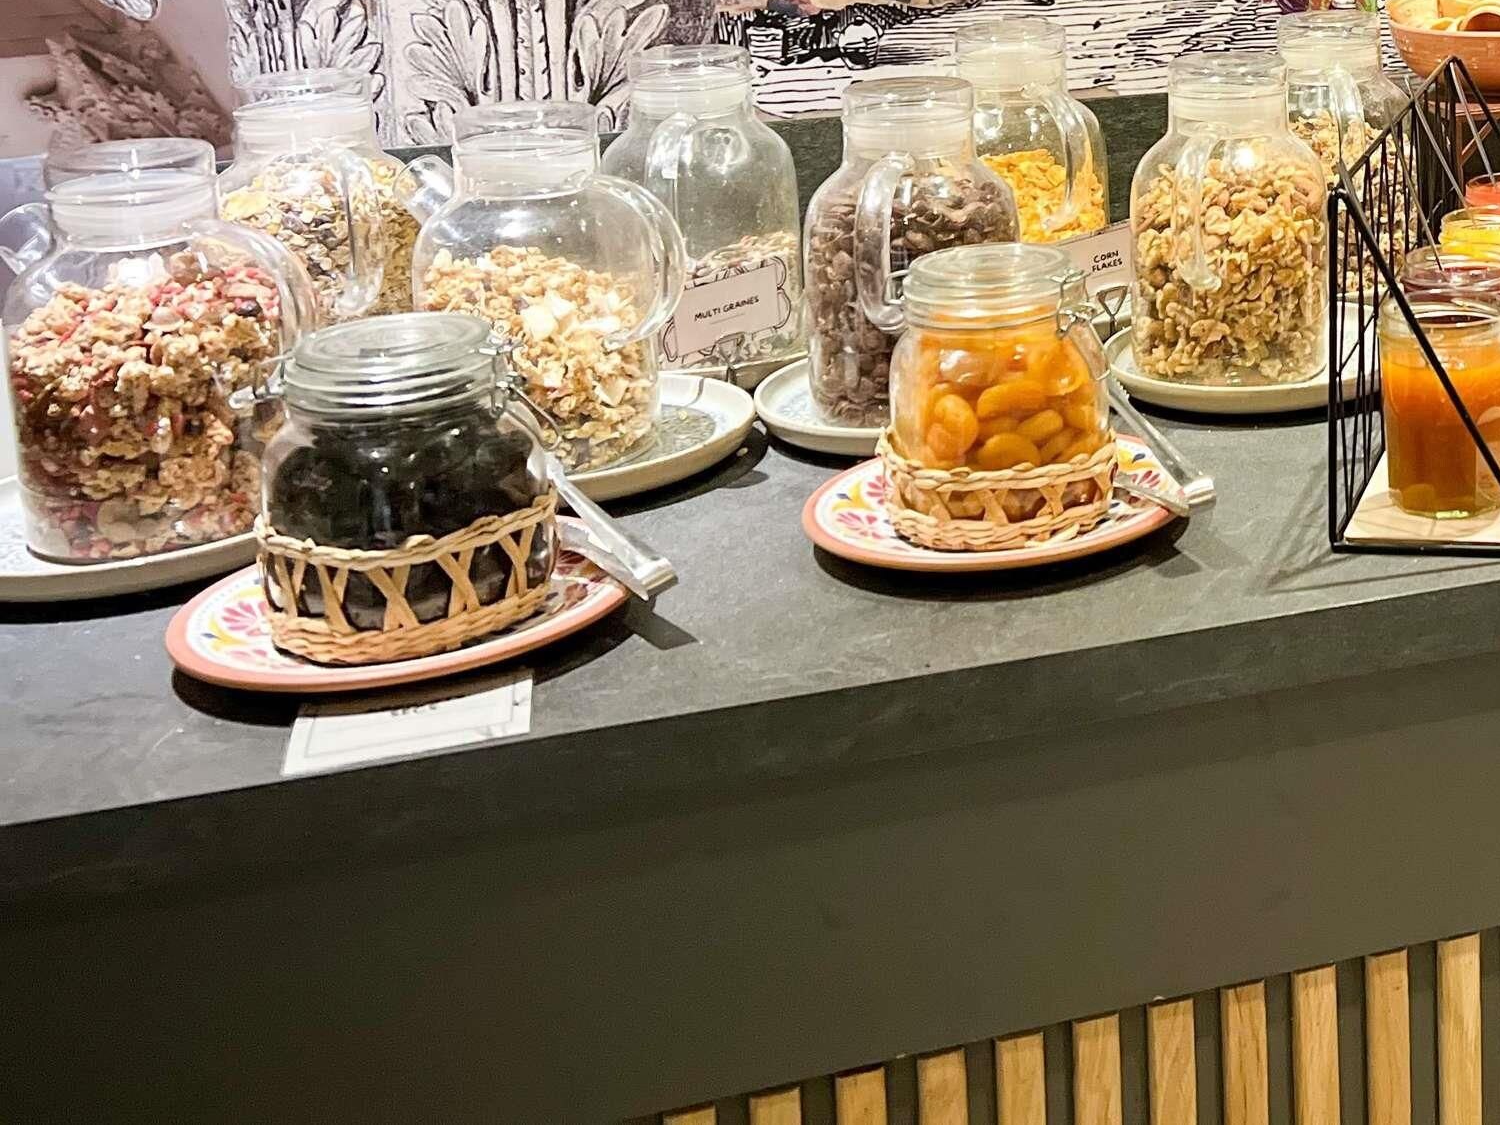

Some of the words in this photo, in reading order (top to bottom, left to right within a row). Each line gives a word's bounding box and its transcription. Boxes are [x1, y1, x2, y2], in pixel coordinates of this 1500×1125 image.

[1093, 250, 1119, 263] CORN
[1092, 258, 1123, 272] FLAKES
[694, 307, 721, 321] MULTI
[723, 295, 759, 313] GRAINES
